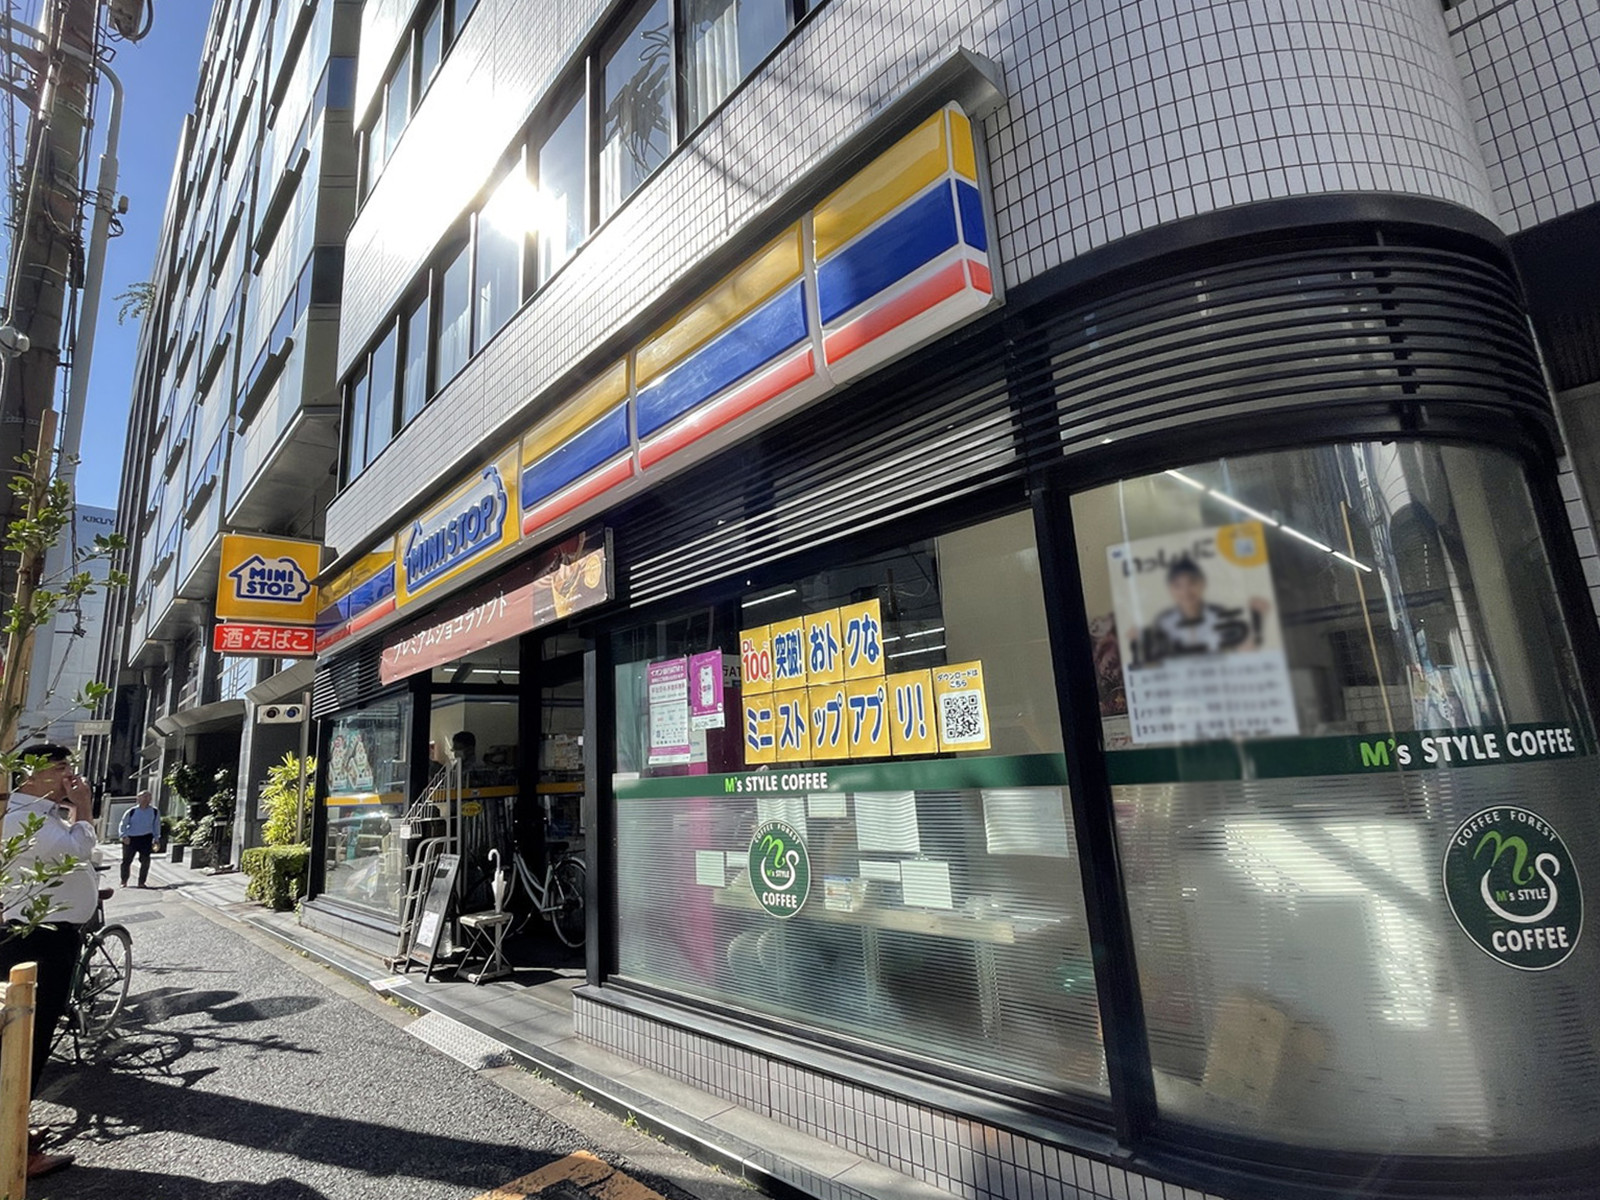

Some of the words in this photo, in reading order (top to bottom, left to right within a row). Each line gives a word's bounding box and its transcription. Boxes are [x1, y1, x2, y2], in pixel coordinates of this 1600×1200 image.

[249, 567, 294, 583] MINI
[246, 581, 296, 596] STOP
[742, 641, 754, 653] DL
[937, 669, 979, 681] ダウンロードは
[949, 680, 967, 688] こちら
[1360, 738, 1412, 767] M's
[1420, 733, 1500, 763] STYLE
[1506, 727, 1576, 757] COFFEE
[725, 777, 743, 793] M's
[745, 775, 778, 793] STYLE
[781, 772, 828, 791] COFFEE
[1457, 810, 1501, 847] COFFEE
[1510, 810, 1557, 843] FOREST
[762, 892, 798, 909] COFFEE
[1518, 887, 1549, 901] STYLE
[1491, 926, 1569, 953] COFFEE
